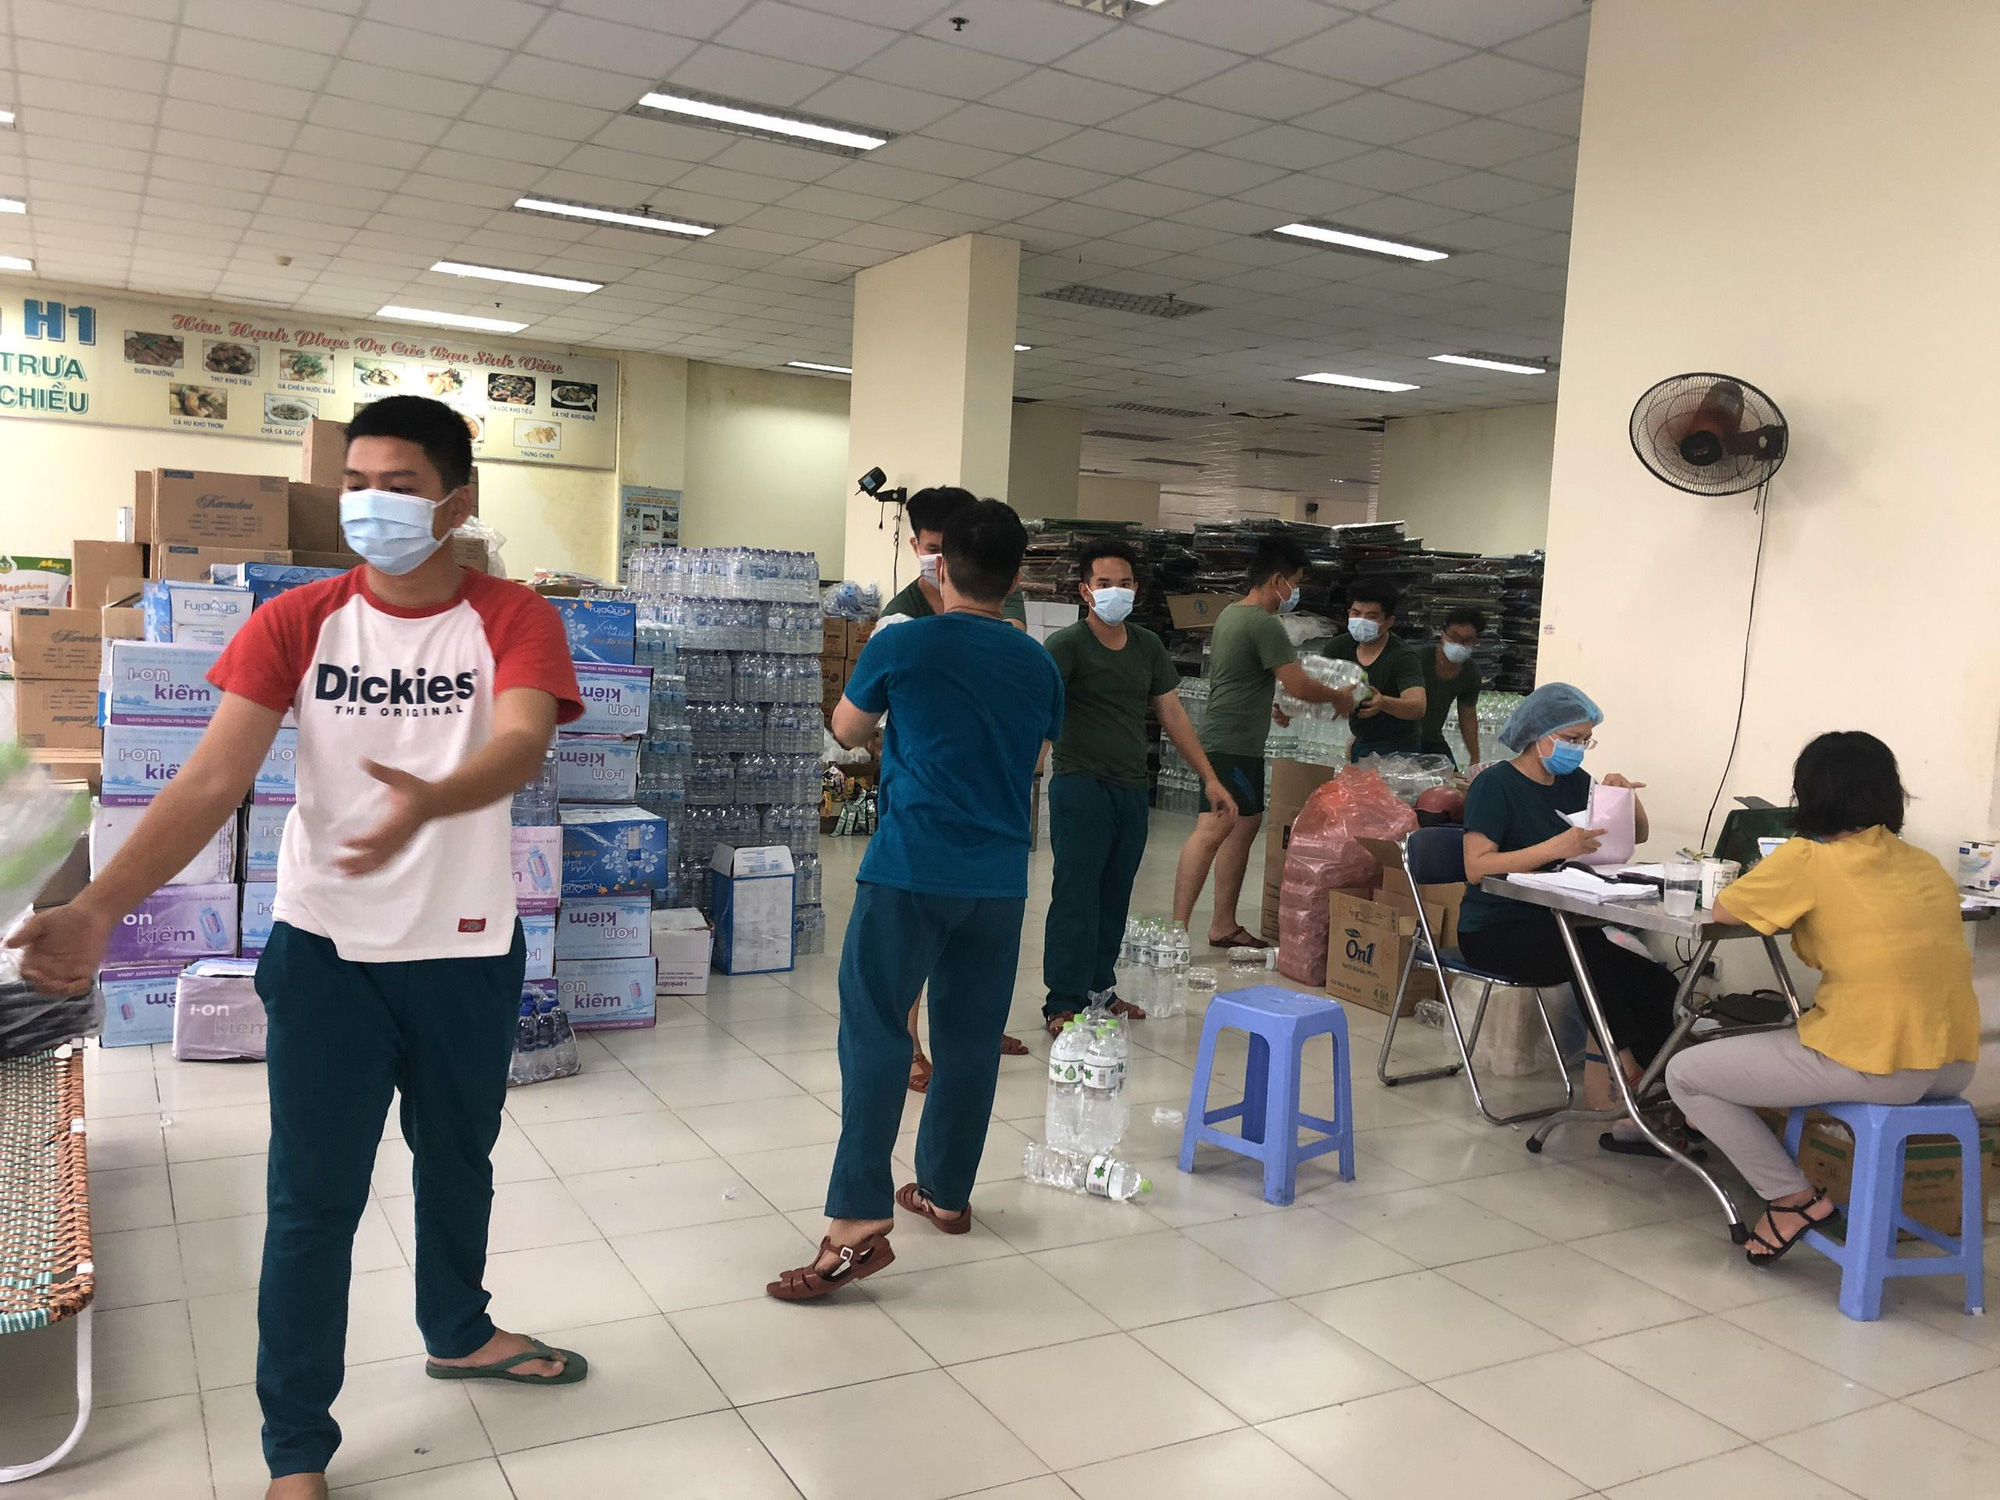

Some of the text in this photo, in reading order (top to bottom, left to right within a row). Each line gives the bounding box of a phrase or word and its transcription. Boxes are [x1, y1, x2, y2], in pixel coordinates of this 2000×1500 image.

[24, 299, 96, 346] H1
[0, 352, 88, 381] TRƯA
[472, 350, 515, 369] Sinh
[0, 381, 89, 415] CHIỀU
[154, 684, 211, 701] kiềm
[316, 663, 475, 704] Dickies
[335, 704, 464, 718] THE ORIGINAL
[559, 752, 605, 767] kiềm
[145, 764, 180, 780] kiề
[569, 912, 617, 928] kiềm
[136, 926, 195, 944] kiềm
[1346, 939, 1376, 967] On1
[574, 993, 621, 1009] kiềm
